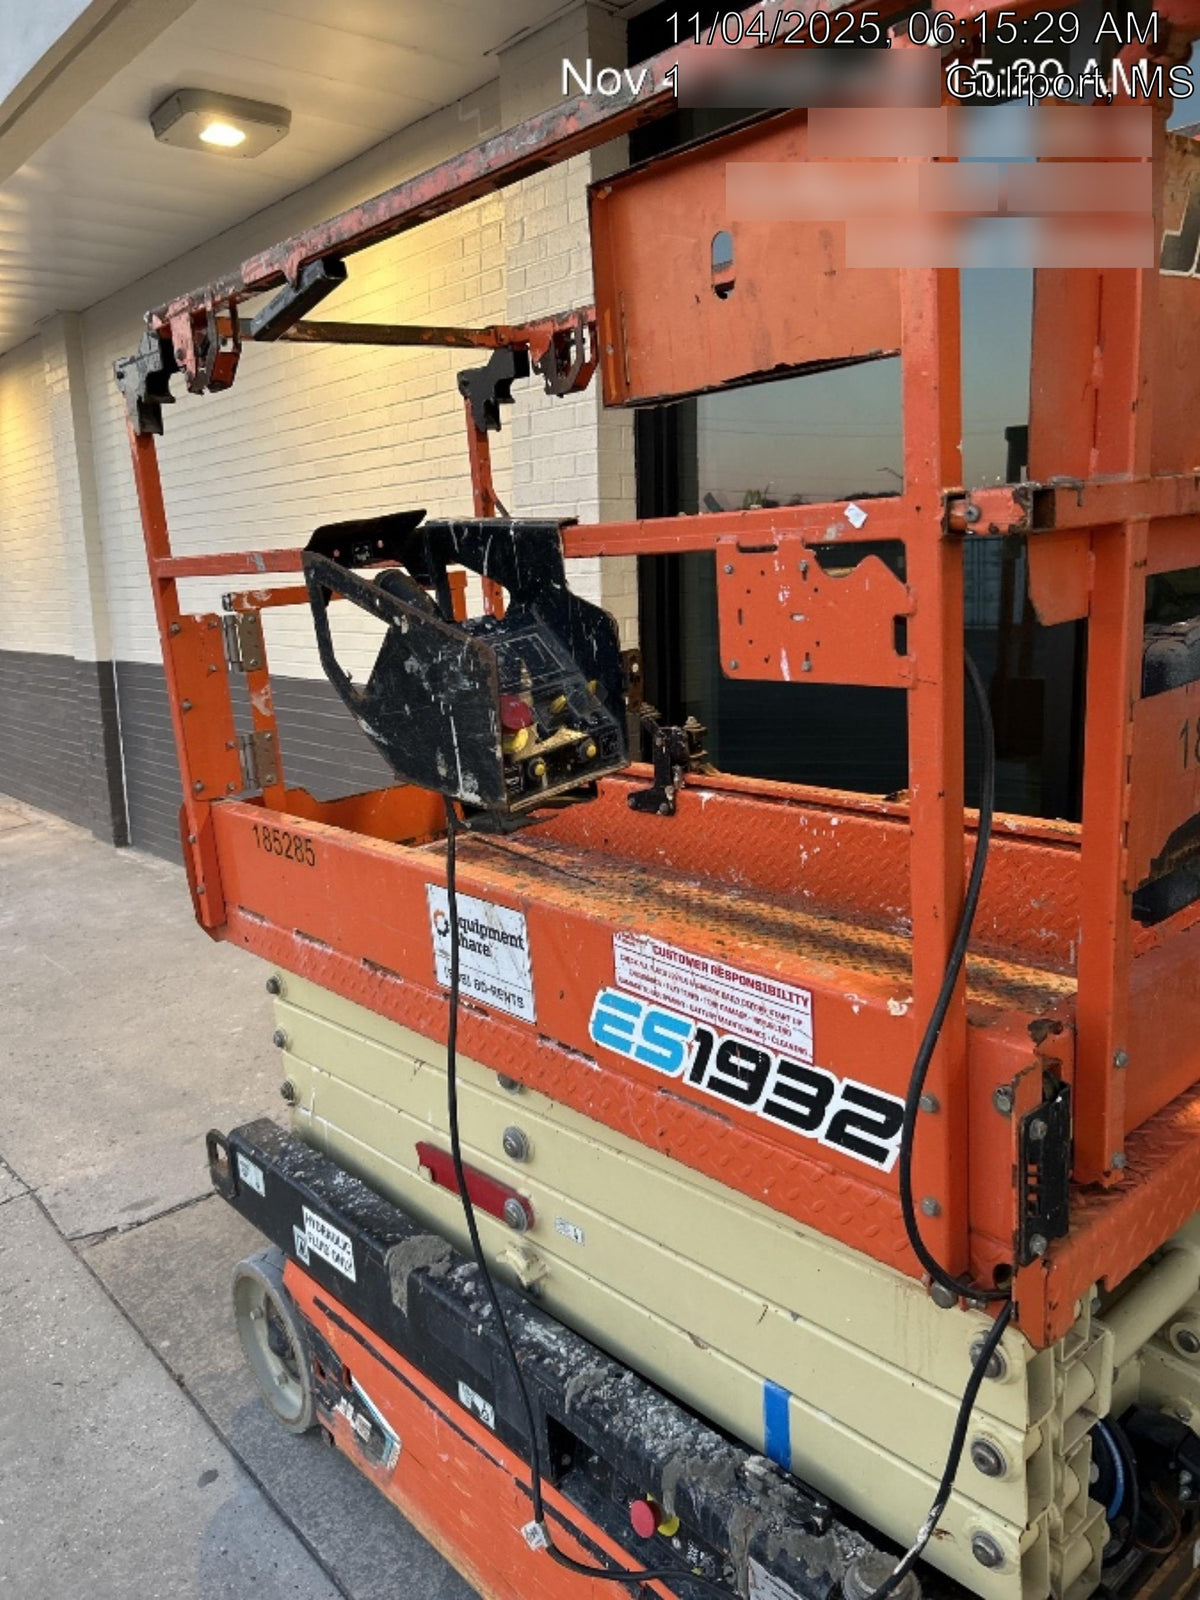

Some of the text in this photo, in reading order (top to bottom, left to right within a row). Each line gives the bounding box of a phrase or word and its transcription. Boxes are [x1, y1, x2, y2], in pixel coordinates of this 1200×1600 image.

[252, 823, 316, 868] 185285
[459, 915, 525, 951] quipment
[459, 933, 492, 958] hare
[652, 944, 709, 975] CUSTOMER
[711, 964, 809, 1008] RESPONSIBILITY
[591, 993, 906, 1165] ES1932
